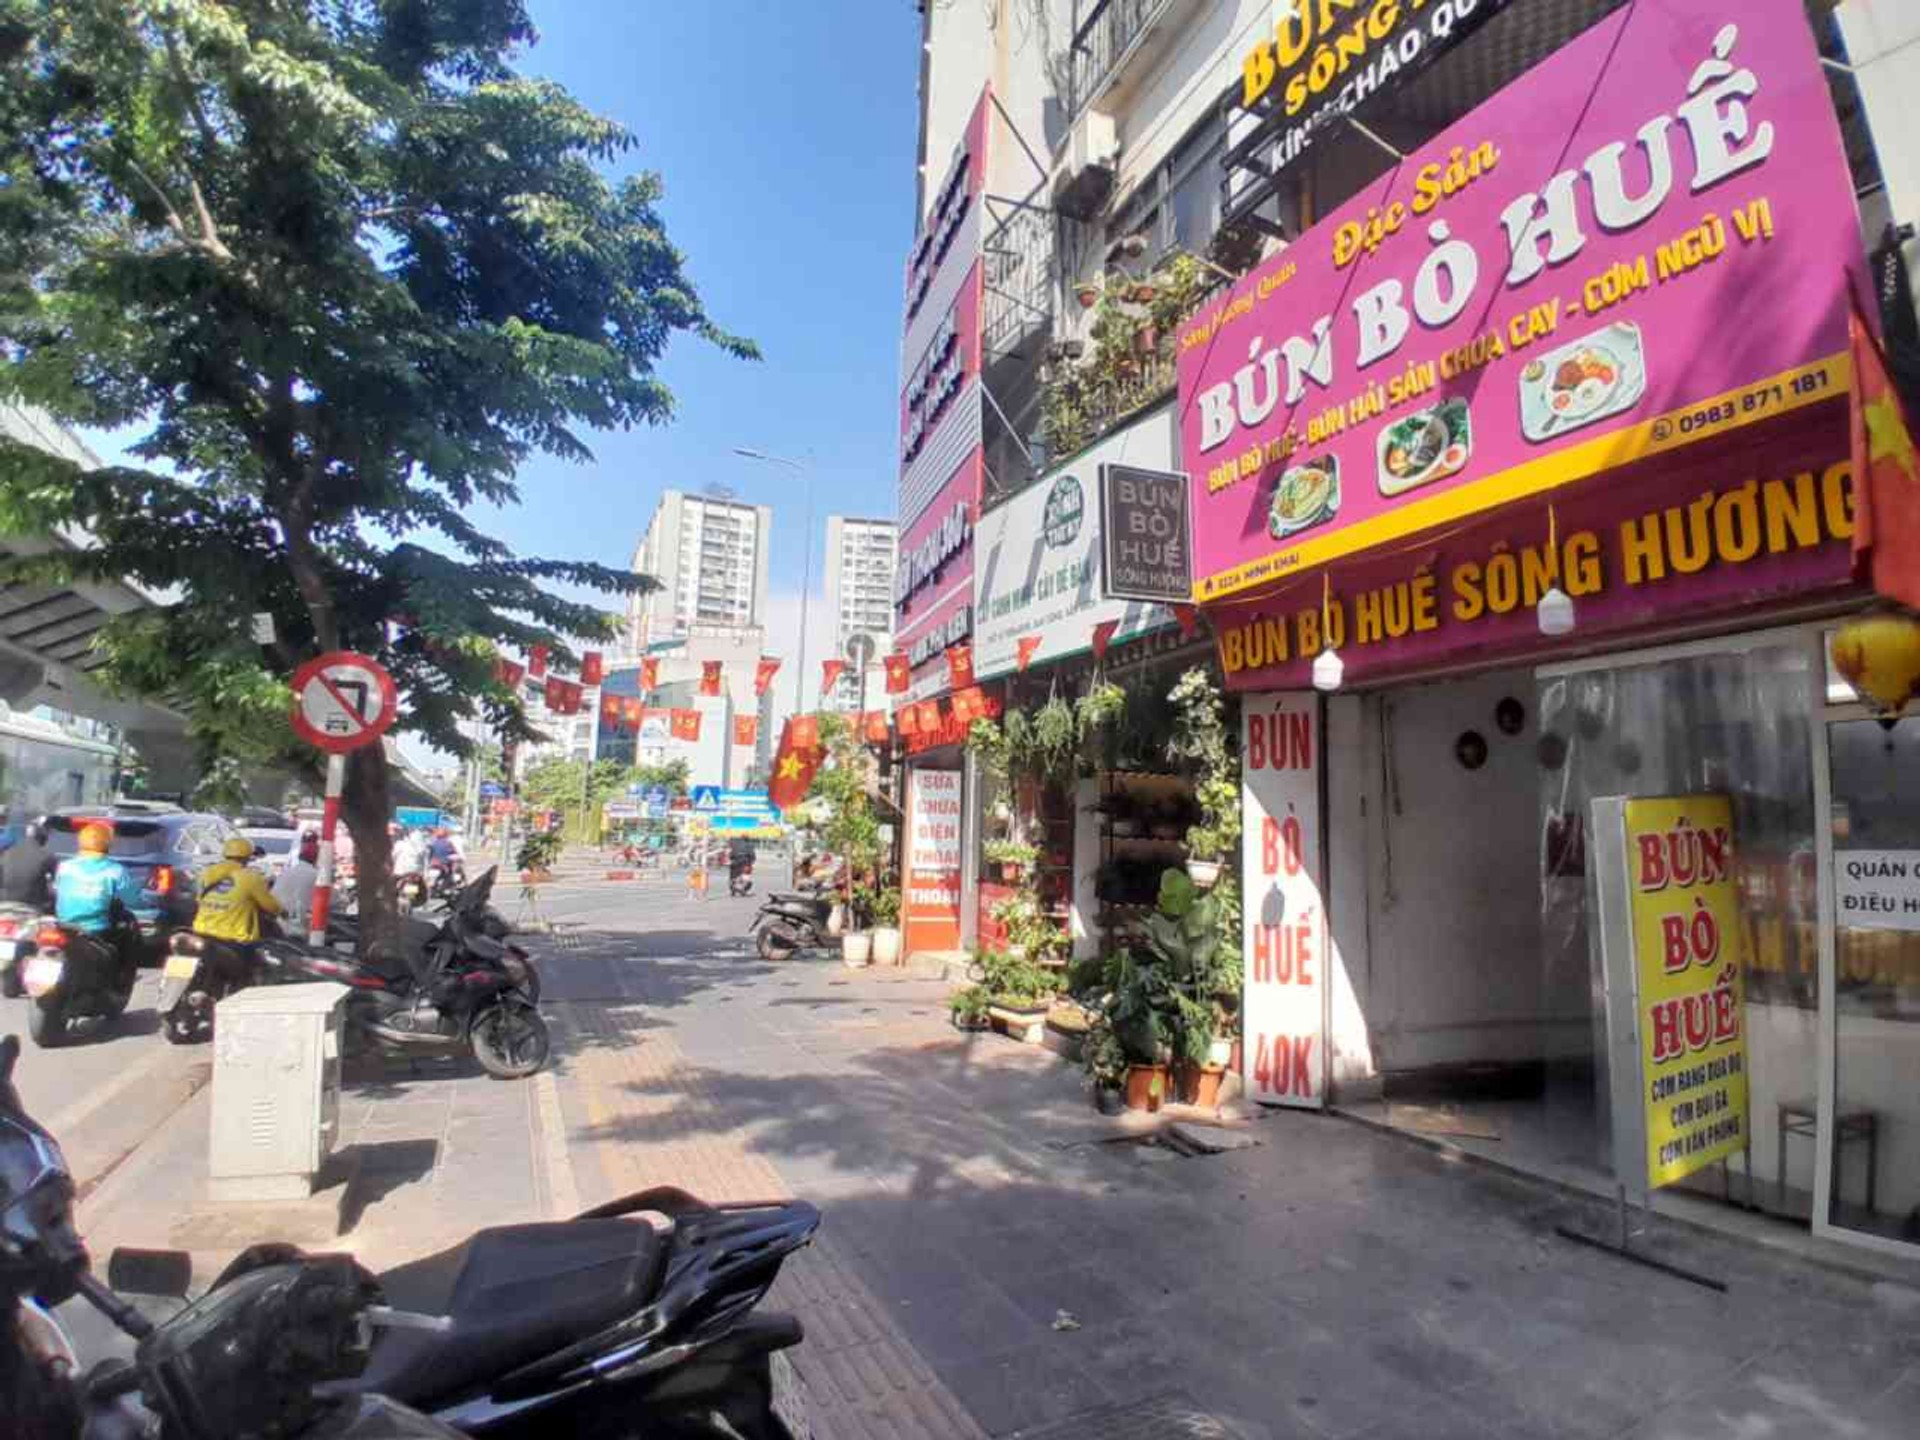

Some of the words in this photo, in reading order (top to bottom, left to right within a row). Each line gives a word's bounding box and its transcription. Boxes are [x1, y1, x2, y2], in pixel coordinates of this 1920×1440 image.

[1284, 0, 1401, 116] SÔNG
[1199, 315, 1335, 455] BÚN
[1353, 218, 1482, 372] BÒ
[1500, 23, 1776, 286] HUẾ
[1333, 202, 1406, 271] Đặc
[1412, 140, 1498, 215] Sản
[1387, 359, 1437, 405] SẢN
[1508, 297, 1563, 350] CAY
[1679, 400, 1737, 434] 0983
[1740, 386, 1784, 414] 871
[1789, 368, 1830, 396] 181
[1116, 478, 1178, 510] BÚN
[1129, 506, 1168, 540] BÒ
[1120, 532, 1183, 569] HUẾ
[1224, 611, 1289, 672] BÚN
[1299, 587, 1345, 657] BÒ
[1355, 552, 1439, 644] HUẾ
[1451, 528, 1602, 622] SÔNG
[1620, 460, 1854, 586] HƯƠNG
[1248, 701, 1312, 770] BÚN
[1261, 803, 1302, 876] BÒ
[1637, 816, 1727, 890] BÚN
[1847, 857, 1906, 880] QUÁN
[1662, 896, 1719, 972] BÒ
[1843, 891, 1895, 912] ĐIỀU
[1253, 905, 1314, 985] HUẾ
[1651, 962, 1738, 1062] HUẾ
[1254, 1033, 1313, 1098] 40K
